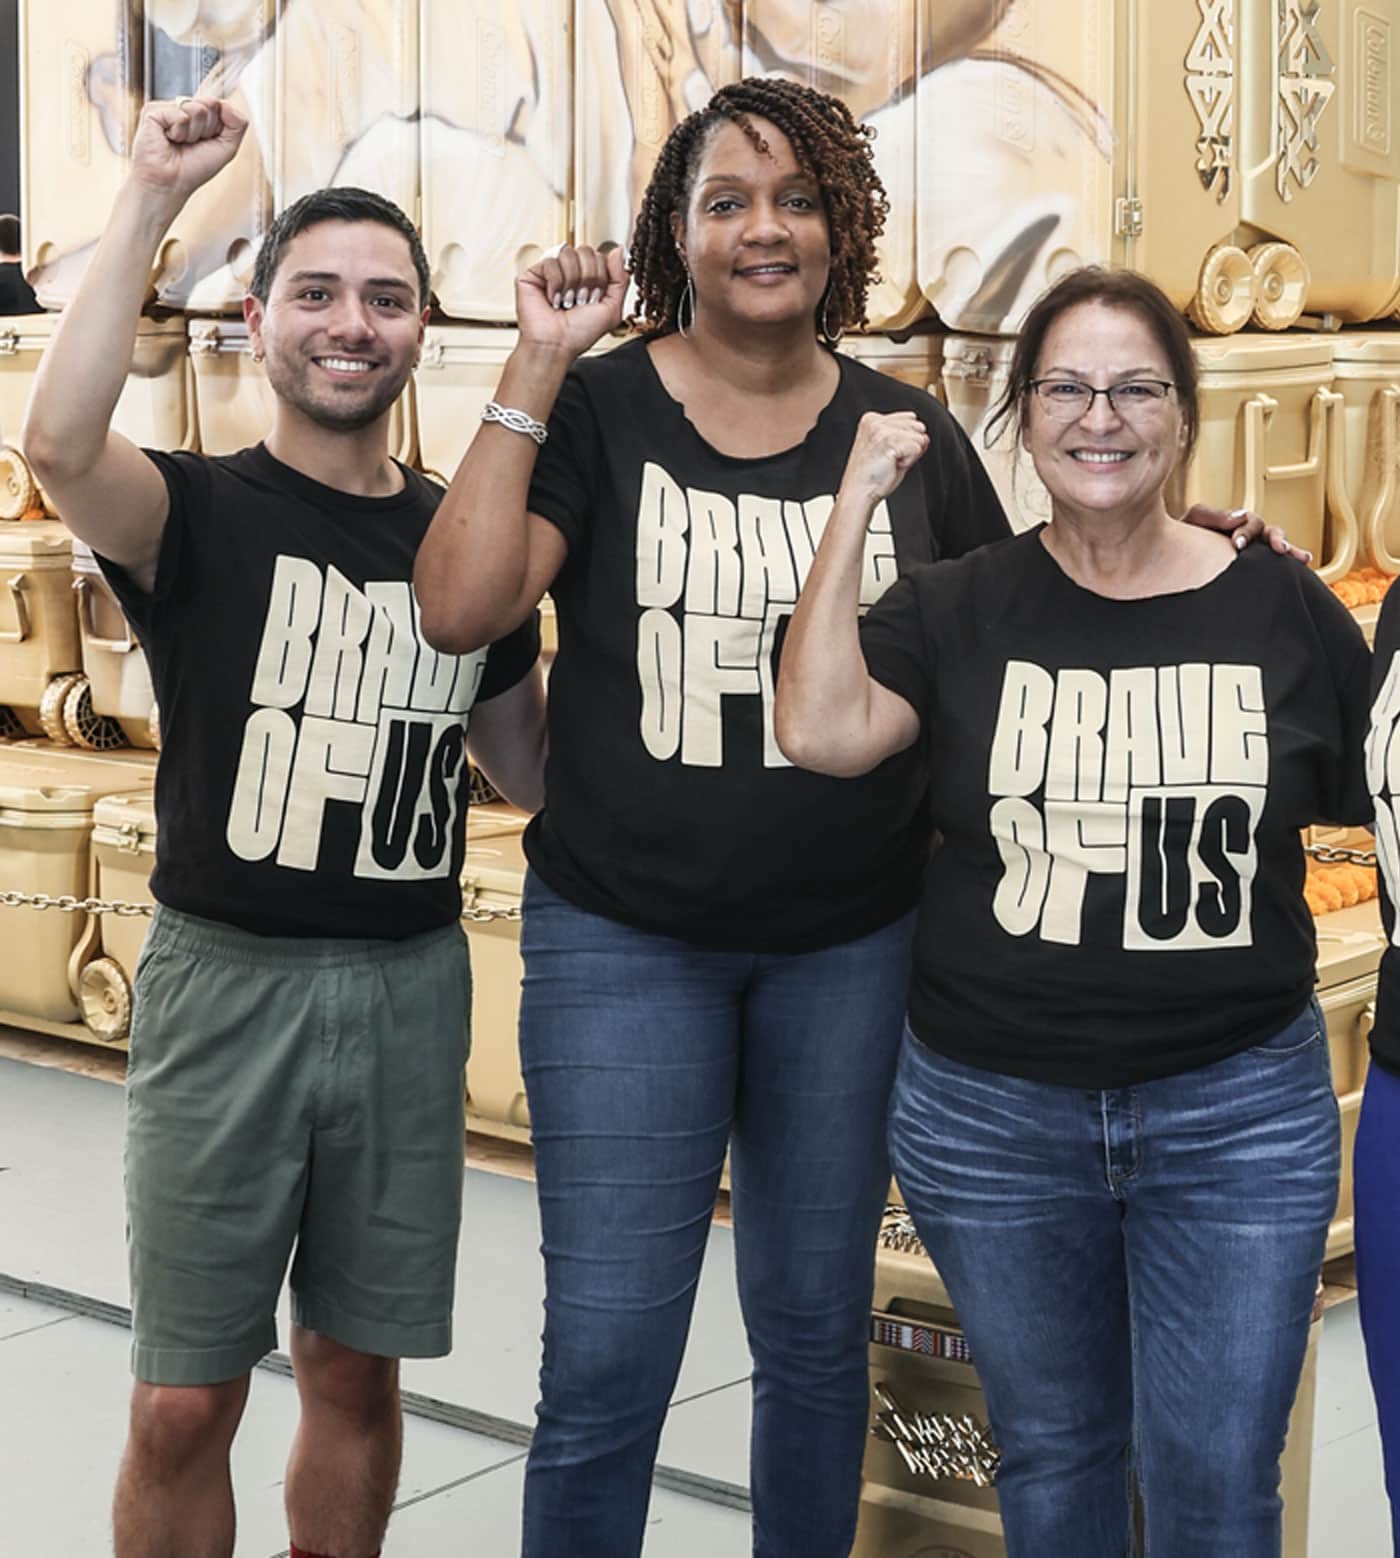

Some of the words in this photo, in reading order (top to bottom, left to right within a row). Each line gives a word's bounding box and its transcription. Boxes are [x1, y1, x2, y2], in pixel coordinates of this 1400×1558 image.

[637, 608, 763, 767] OF
[988, 660, 1269, 802] BRAVE
[226, 707, 377, 872] OF
[371, 719, 465, 871] US
[989, 797, 1127, 945] OF
[1138, 794, 1251, 940] US
